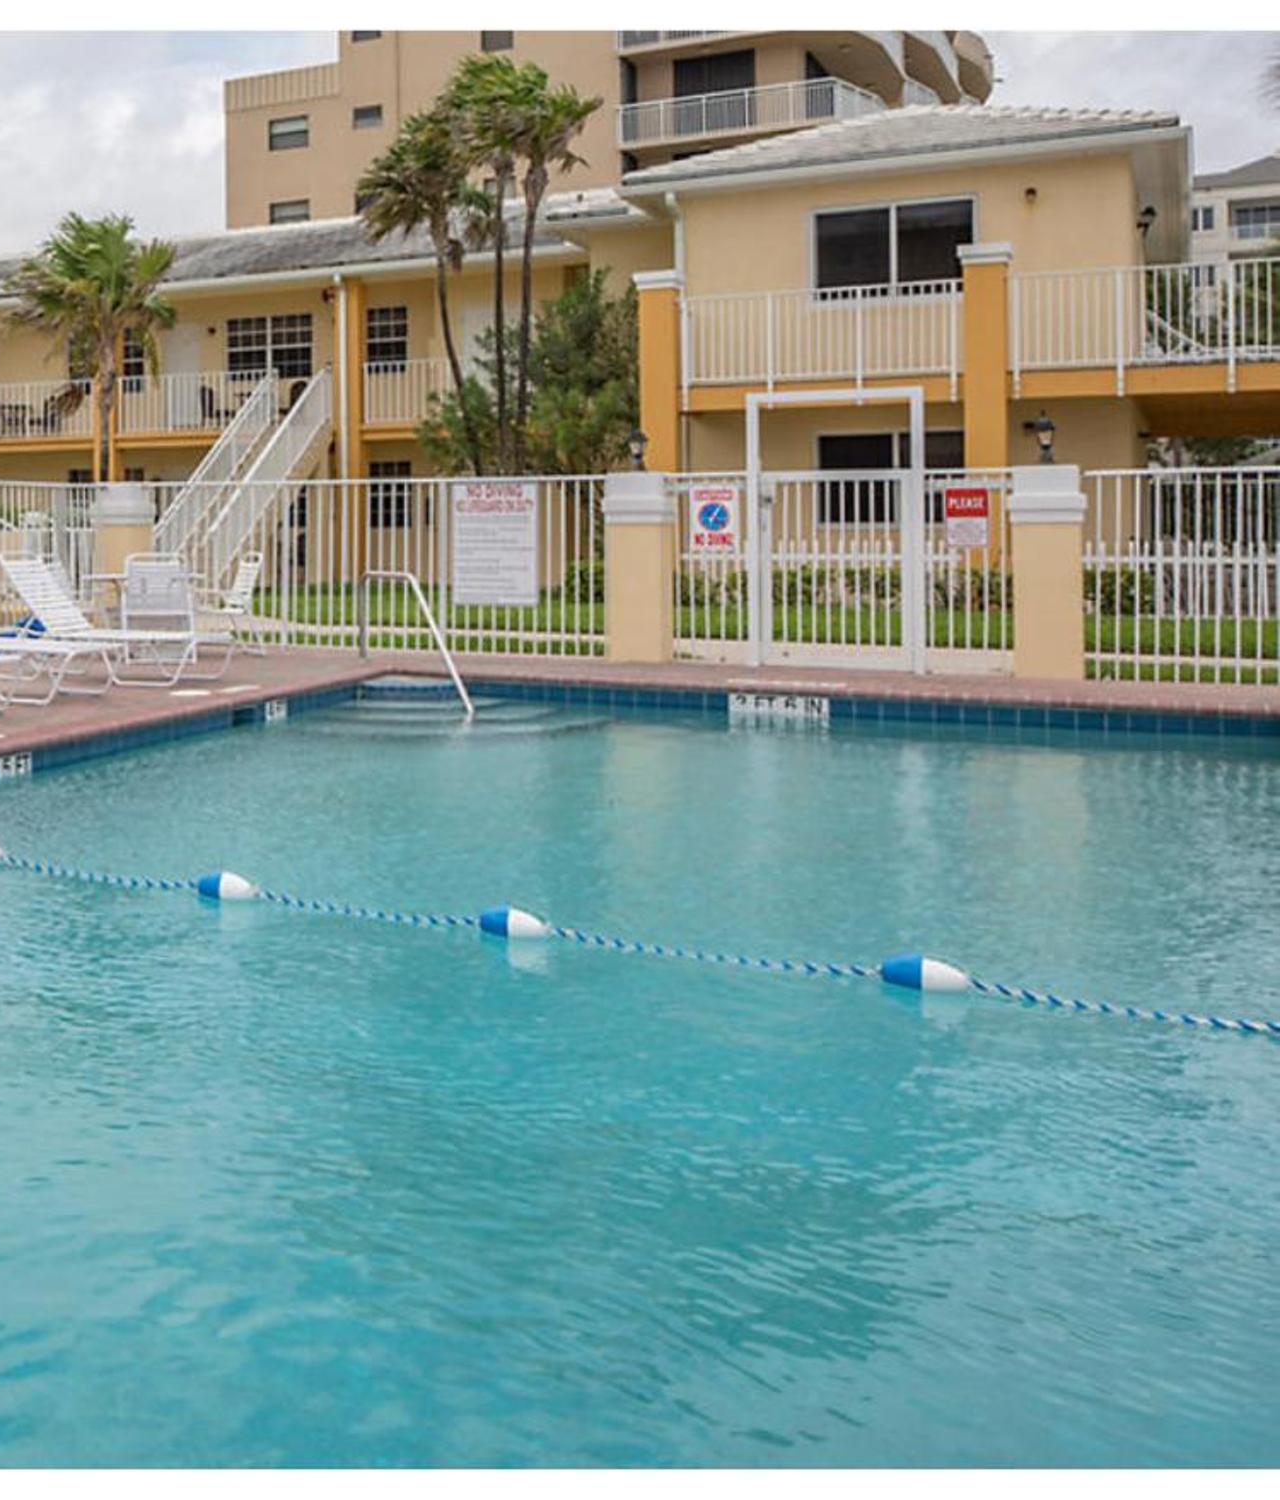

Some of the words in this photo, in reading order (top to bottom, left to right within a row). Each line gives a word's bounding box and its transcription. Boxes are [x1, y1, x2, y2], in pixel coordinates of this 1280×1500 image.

[467, 484, 481, 498] NO
[485, 484, 523, 498] DIVING
[948, 496, 985, 509] PLEASE
[694, 532, 705, 546] NO
[707, 532, 733, 546] DIVING
[754, 695, 775, 709] FT
[803, 696, 822, 714] IN
